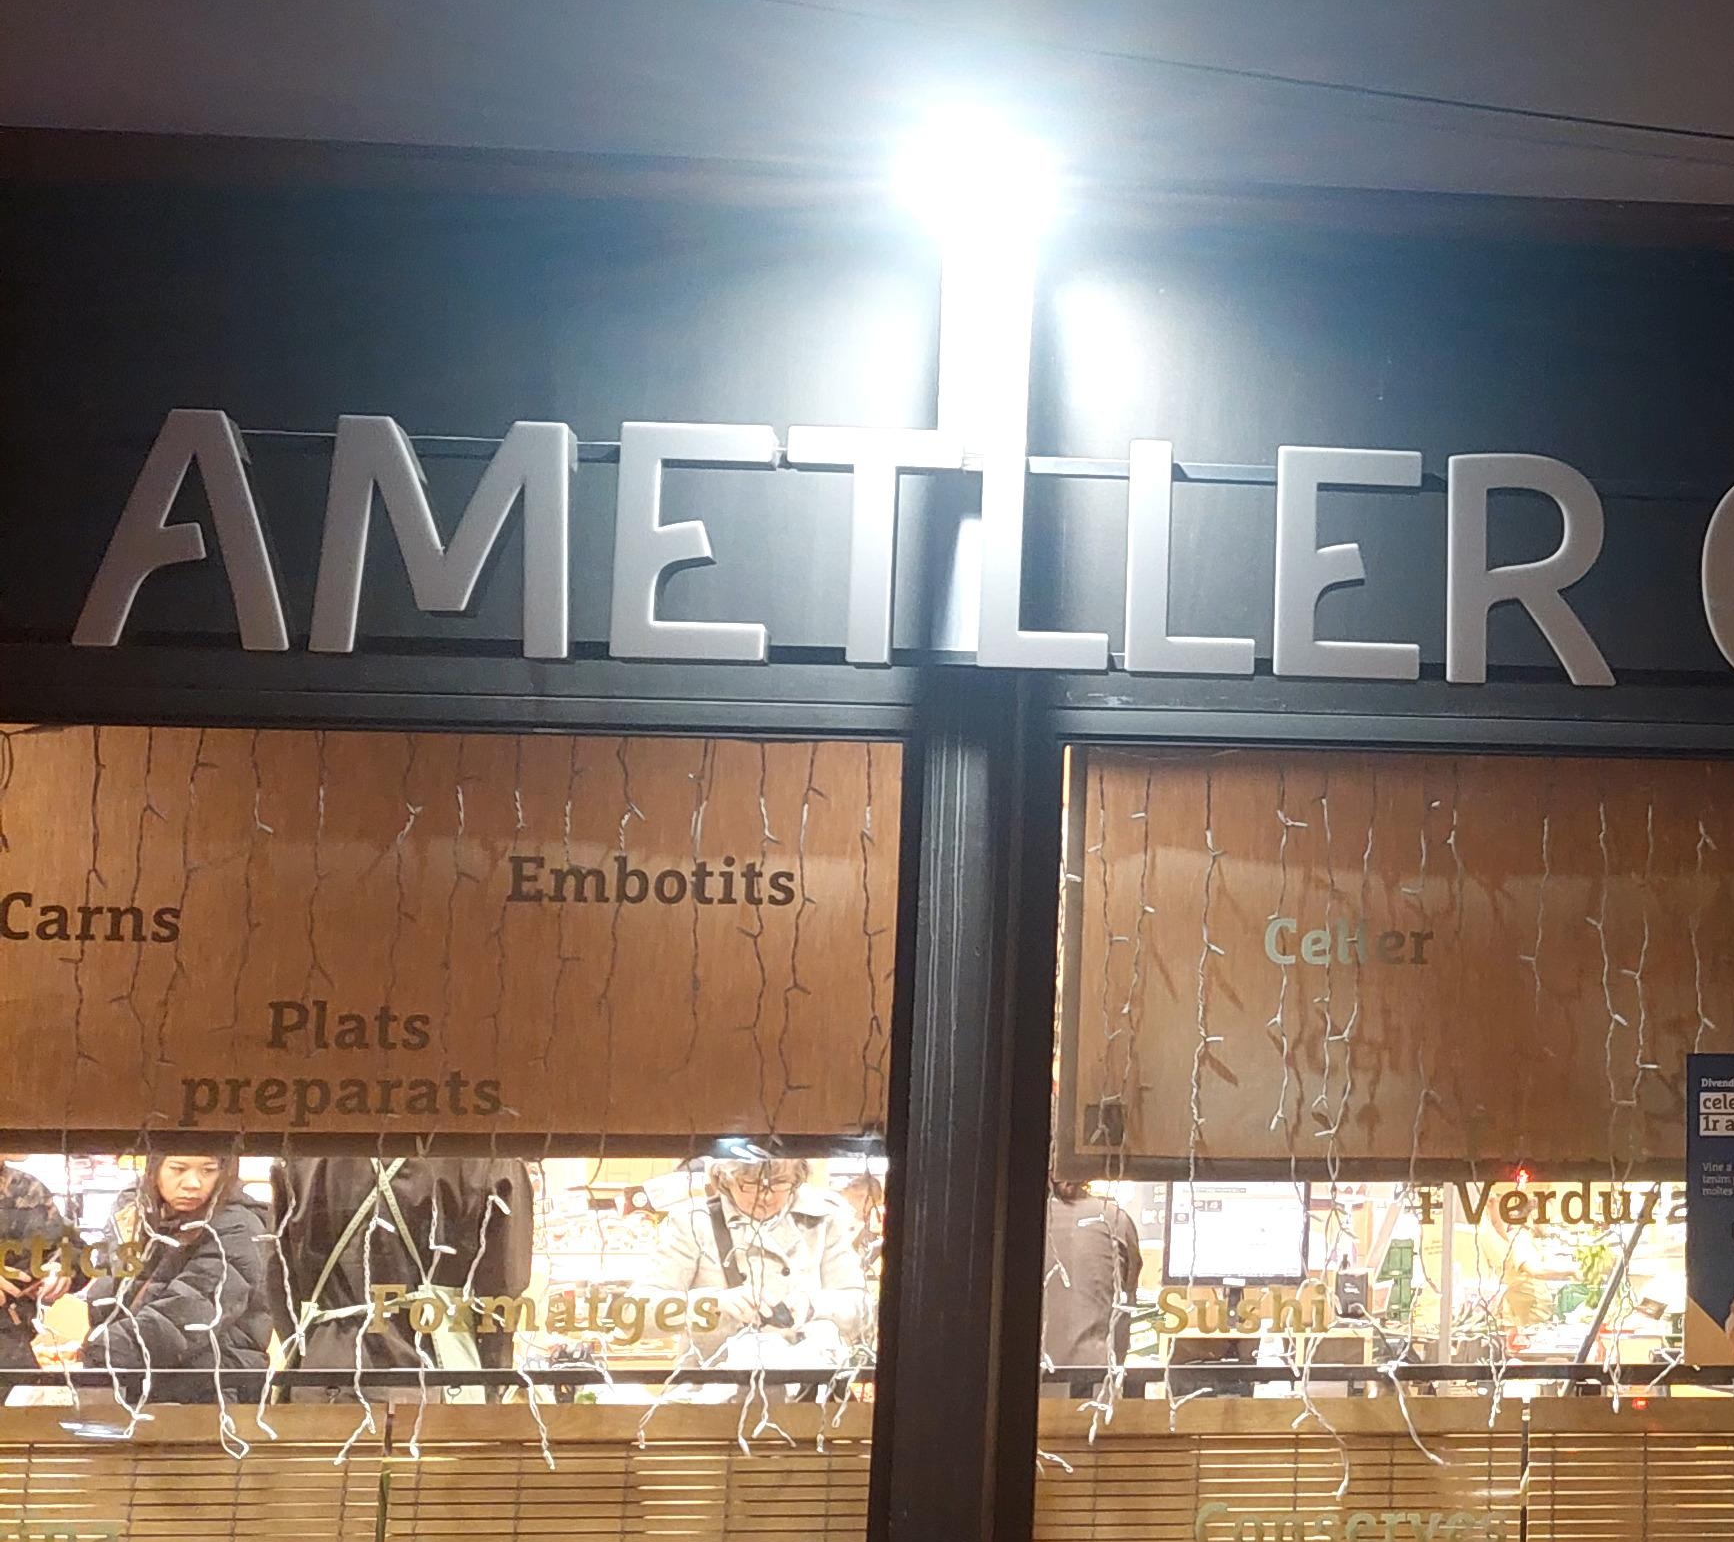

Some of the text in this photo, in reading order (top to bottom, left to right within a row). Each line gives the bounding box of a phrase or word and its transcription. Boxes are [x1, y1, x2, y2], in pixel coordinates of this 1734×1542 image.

[72, 409, 1616, 687] AMETLLER
[508, 855, 796, 907] Embotits
[0, 892, 182, 944] Carns
[1265, 917, 1434, 966] Celler
[267, 1000, 431, 1051] Plats
[180, 1069, 502, 1126] preparats
[1702, 1115, 1722, 1132] 1r
[368, 1283, 721, 1352] Formatges
[1156, 1283, 1329, 1334] Sushi
